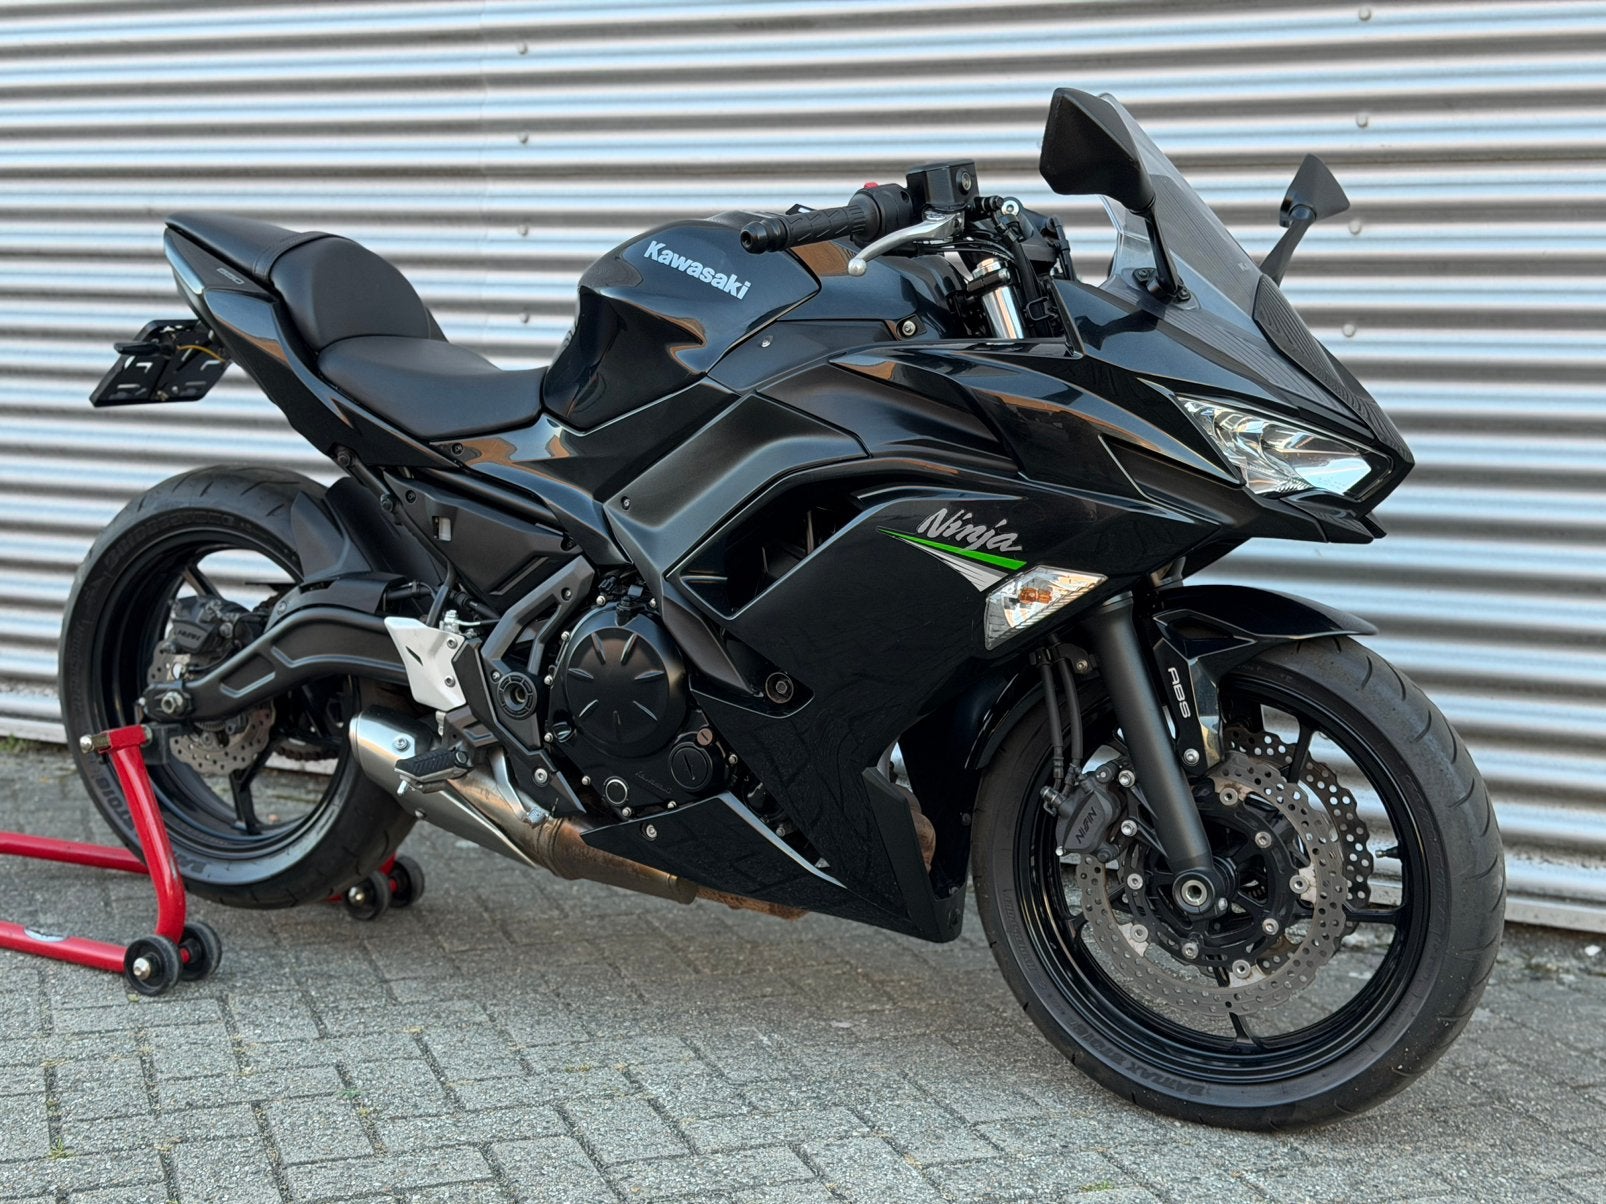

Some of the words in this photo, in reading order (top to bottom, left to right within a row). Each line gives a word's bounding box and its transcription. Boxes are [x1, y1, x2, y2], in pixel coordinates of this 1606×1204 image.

[644, 241, 751, 300] Kawasaki
[917, 508, 1022, 551] Ninja
[1167, 667, 1191, 718] ABS
